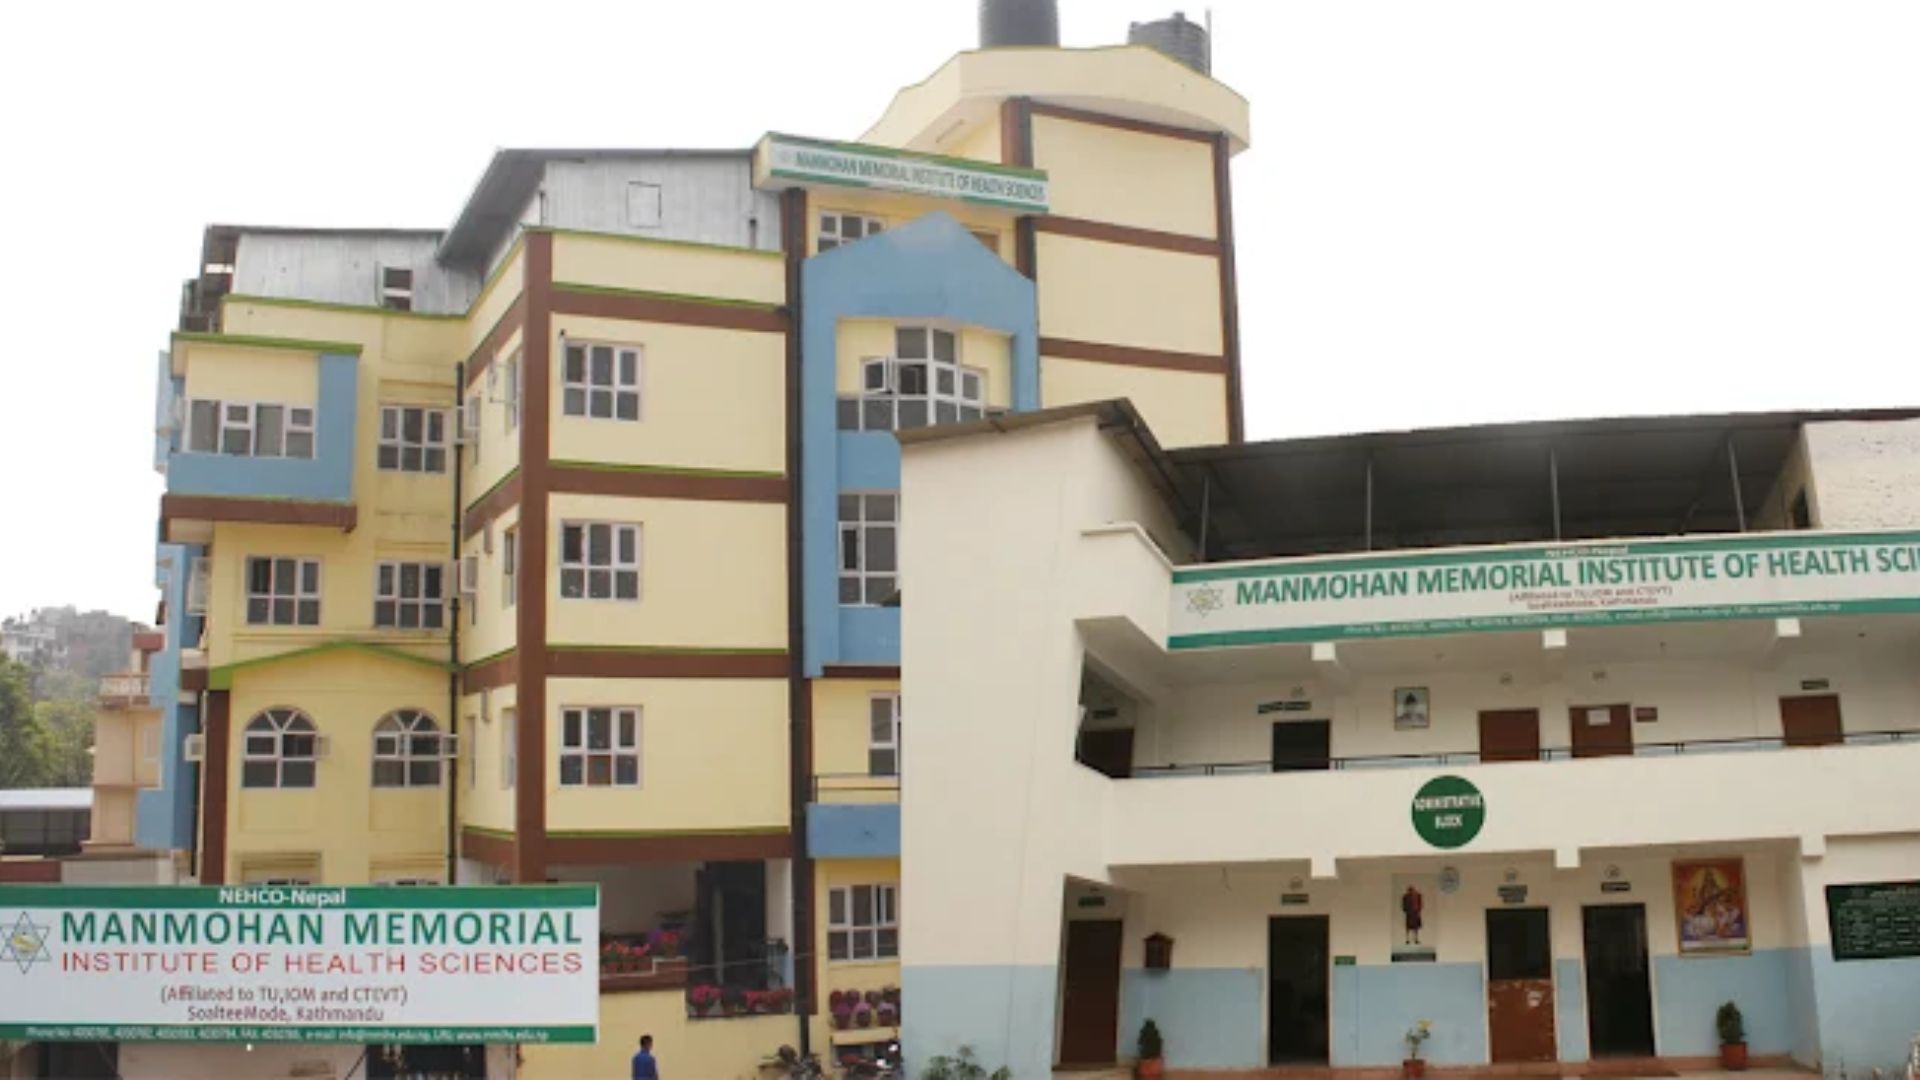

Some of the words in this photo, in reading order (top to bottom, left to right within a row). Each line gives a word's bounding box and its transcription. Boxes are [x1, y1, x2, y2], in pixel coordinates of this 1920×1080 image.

[1236, 570, 1408, 605] MANMOHAN
[1418, 560, 1572, 596] MEMORIAL
[1579, 554, 1717, 586] INSTITUTE
[1724, 552, 1759, 579] OF
[1769, 548, 1870, 578] HEALTH
[219, 888, 346, 907] NEHCO-Nepal
[61, 911, 323, 945] MANMOHAN
[344, 911, 583, 945] MEMORIAL
[62, 952, 219, 973] INSTITUTE
[231, 952, 272, 973] OF
[285, 952, 406, 974] HEALTH
[419, 951, 583, 974] SCIENCES
[161, 985, 233, 1005] (Affiliated
[237, 986, 254, 1002] to
[320, 985, 348, 1002] and
[297, 1004, 385, 1021] Kathmandu
